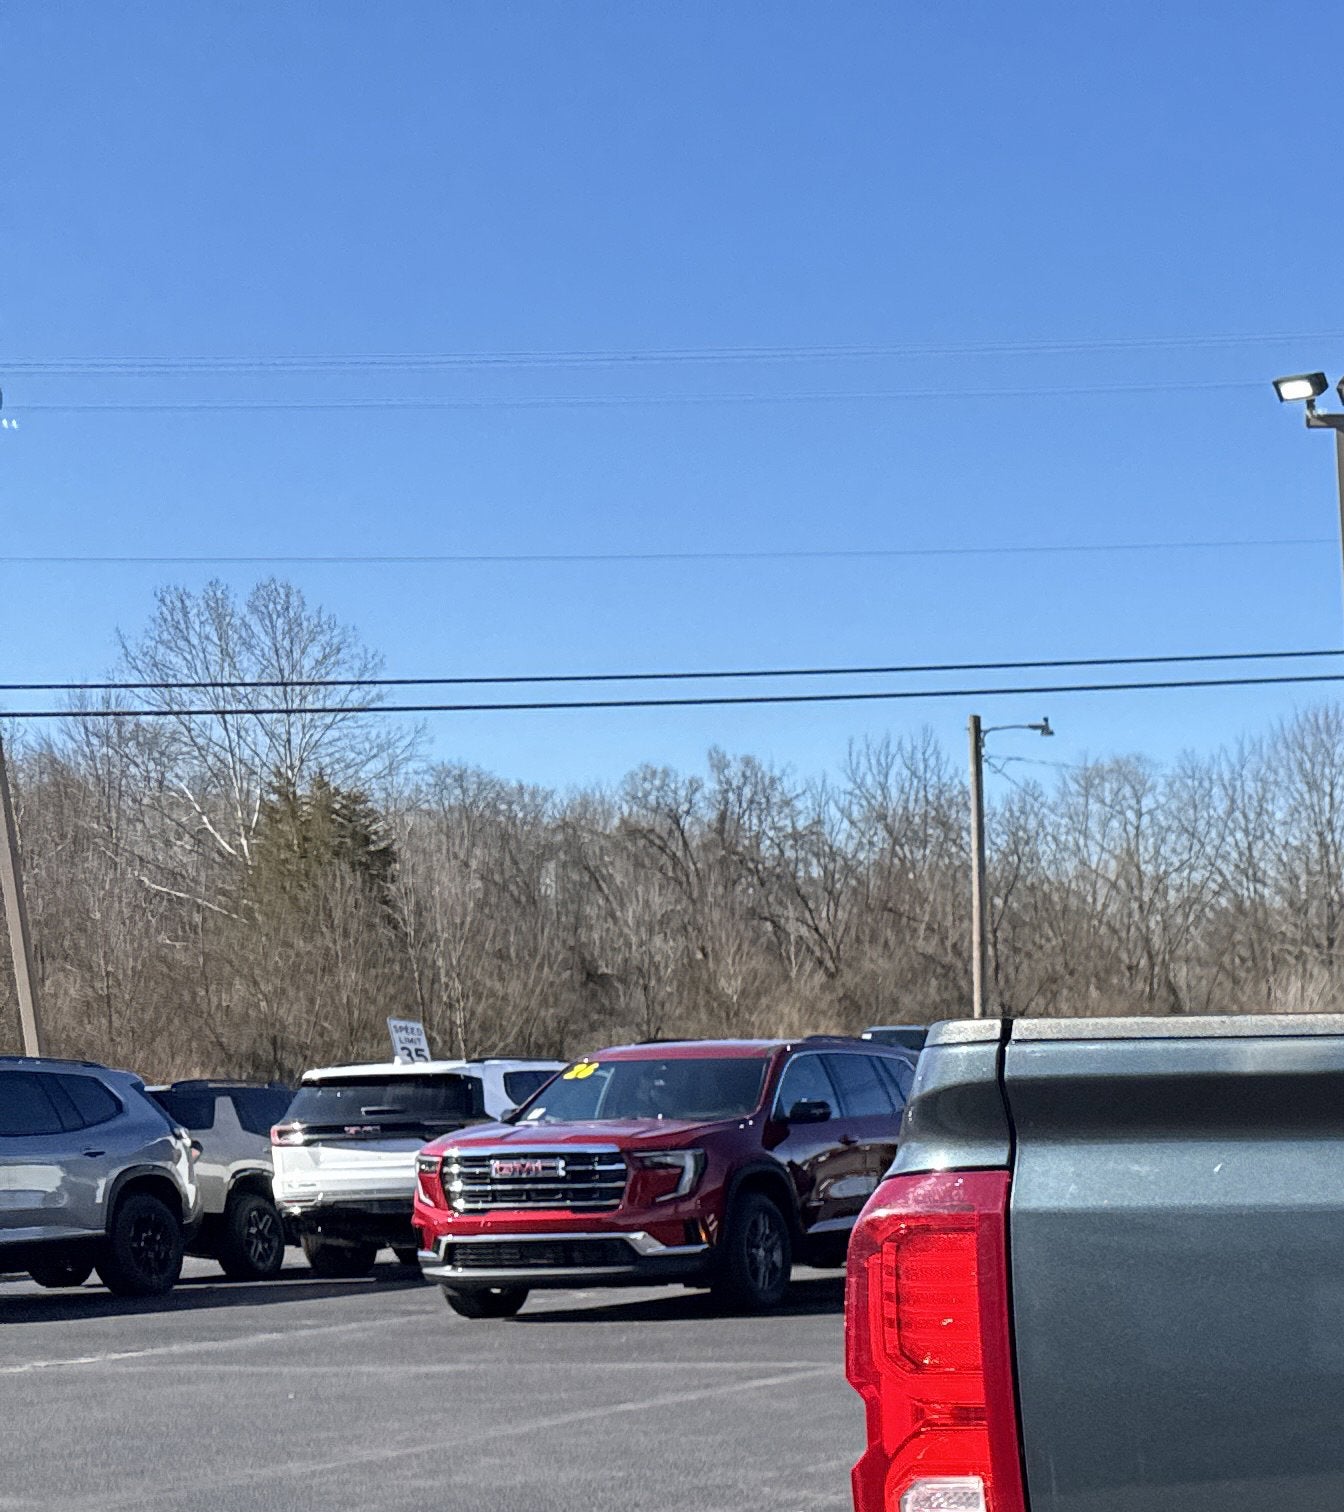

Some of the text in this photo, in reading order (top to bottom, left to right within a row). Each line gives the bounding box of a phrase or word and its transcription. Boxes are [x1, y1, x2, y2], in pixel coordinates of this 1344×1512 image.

[392, 1024, 423, 1036] SPEED
[398, 1036, 421, 1046] LIMIT
[400, 1046, 429, 1063] 35
